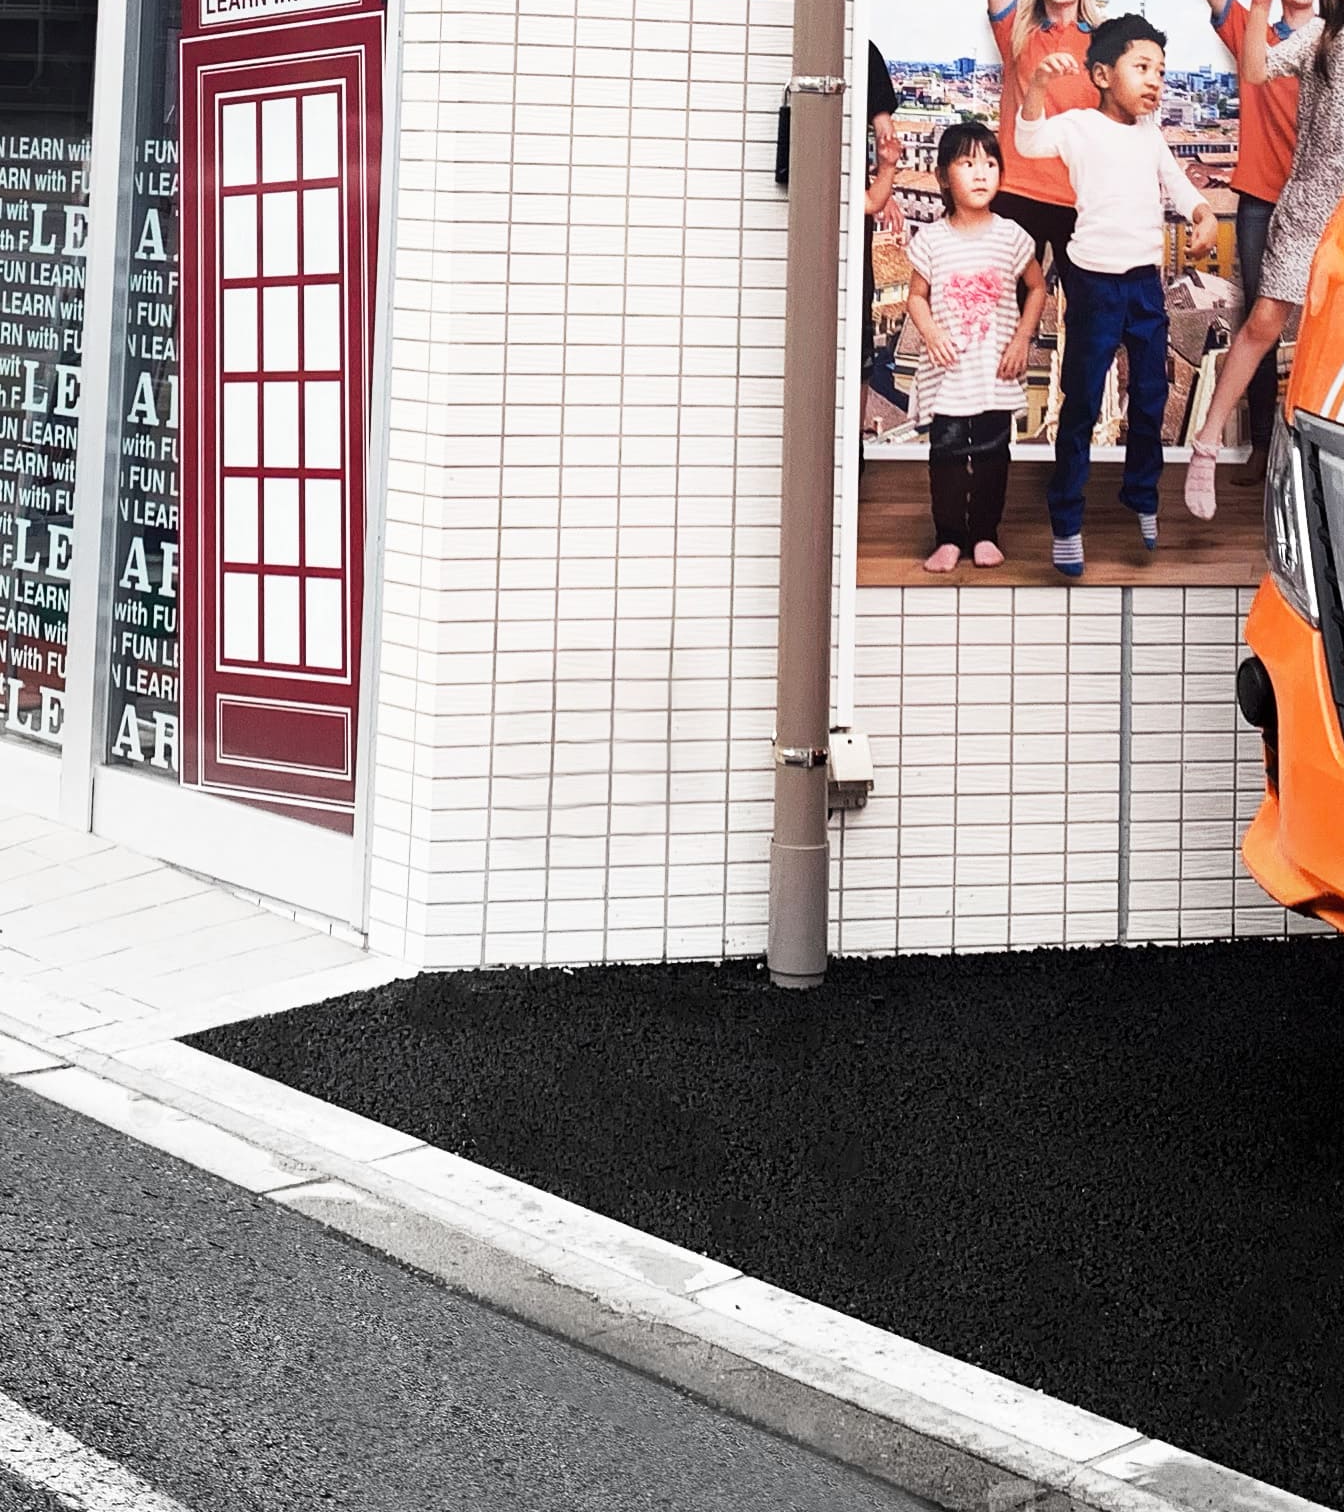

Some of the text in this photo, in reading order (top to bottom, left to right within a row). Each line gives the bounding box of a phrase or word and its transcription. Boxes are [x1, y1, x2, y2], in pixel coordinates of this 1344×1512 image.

[9, 136, 64, 160] LEARN
[144, 139, 178, 164] FUN
[34, 167, 67, 192] with
[30, 262, 85, 289] LEARN
[130, 268, 163, 295] with
[2, 292, 57, 317] LEARN
[137, 301, 172, 328] FUN
[27, 326, 59, 350] with
[22, 420, 77, 450] LEARN
[122, 433, 155, 460] with
[129, 465, 164, 495] FUN
[18, 485, 50, 512] with
[14, 581, 69, 612] LEARN
[114, 599, 147, 628] with
[10, 643, 42, 673] with
[121, 631, 156, 664] FUN
